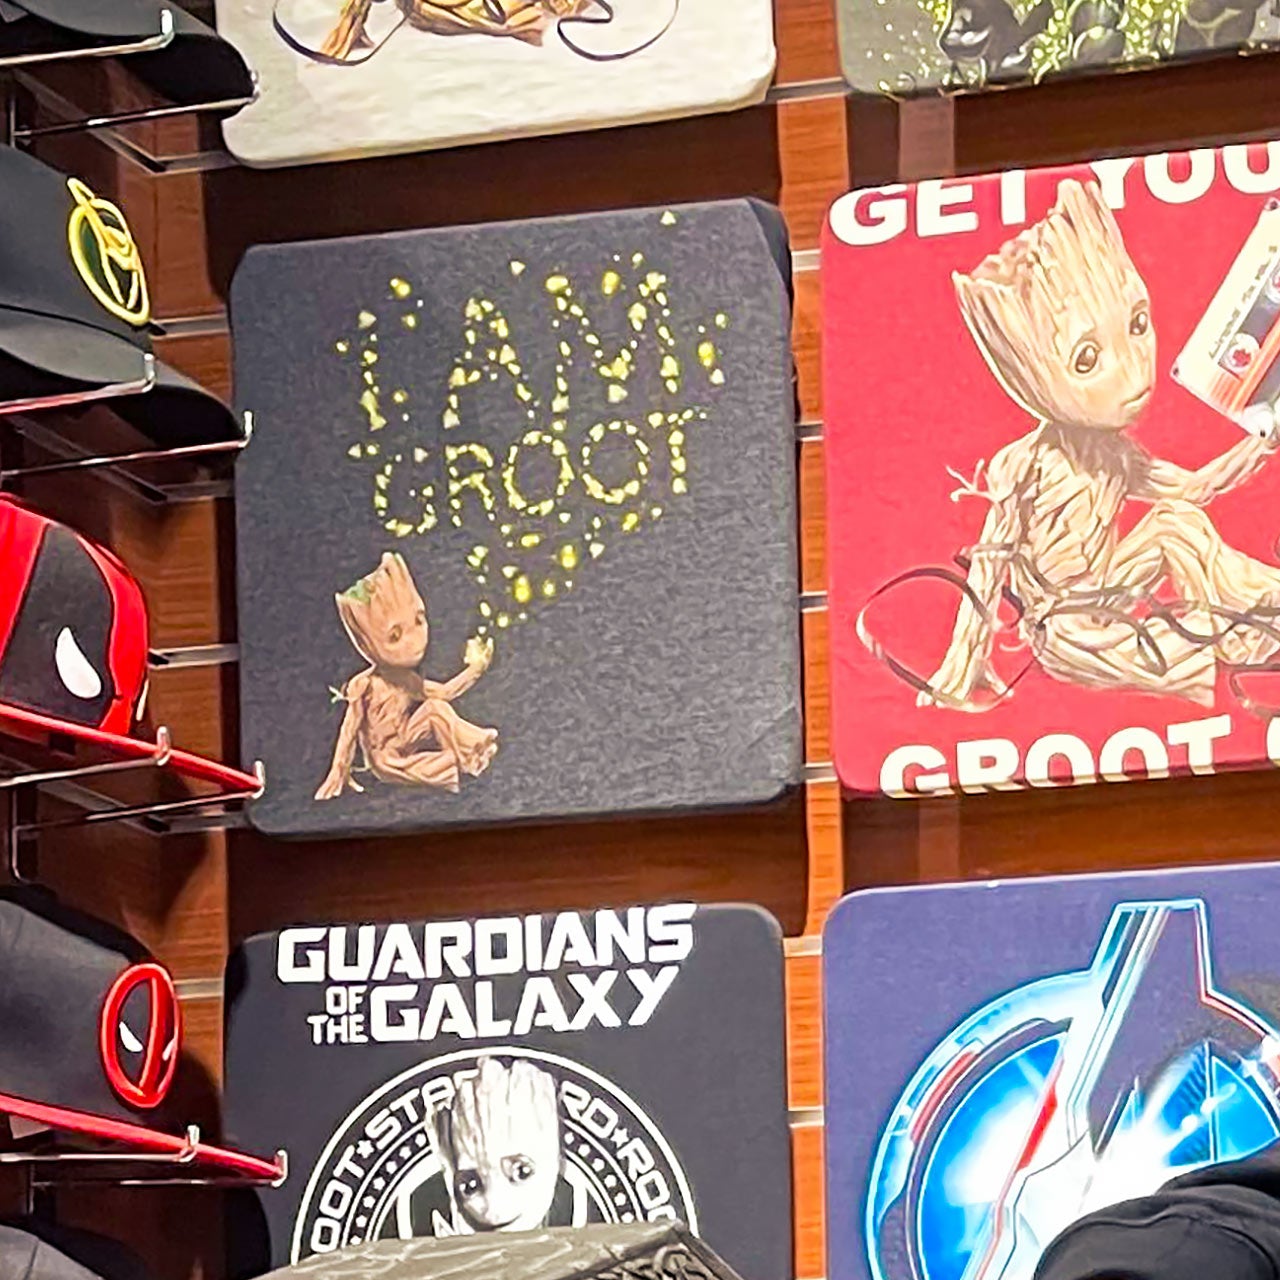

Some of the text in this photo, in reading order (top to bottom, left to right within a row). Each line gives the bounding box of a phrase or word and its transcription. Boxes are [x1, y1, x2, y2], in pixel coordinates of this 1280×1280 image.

[374, 410, 708, 535] GROOT
[880, 715, 1231, 798] GROOT
[277, 903, 697, 983] GUARDIANS
[307, 1015, 368, 1045] THE
[325, 966, 680, 1043] OF GALAXY
